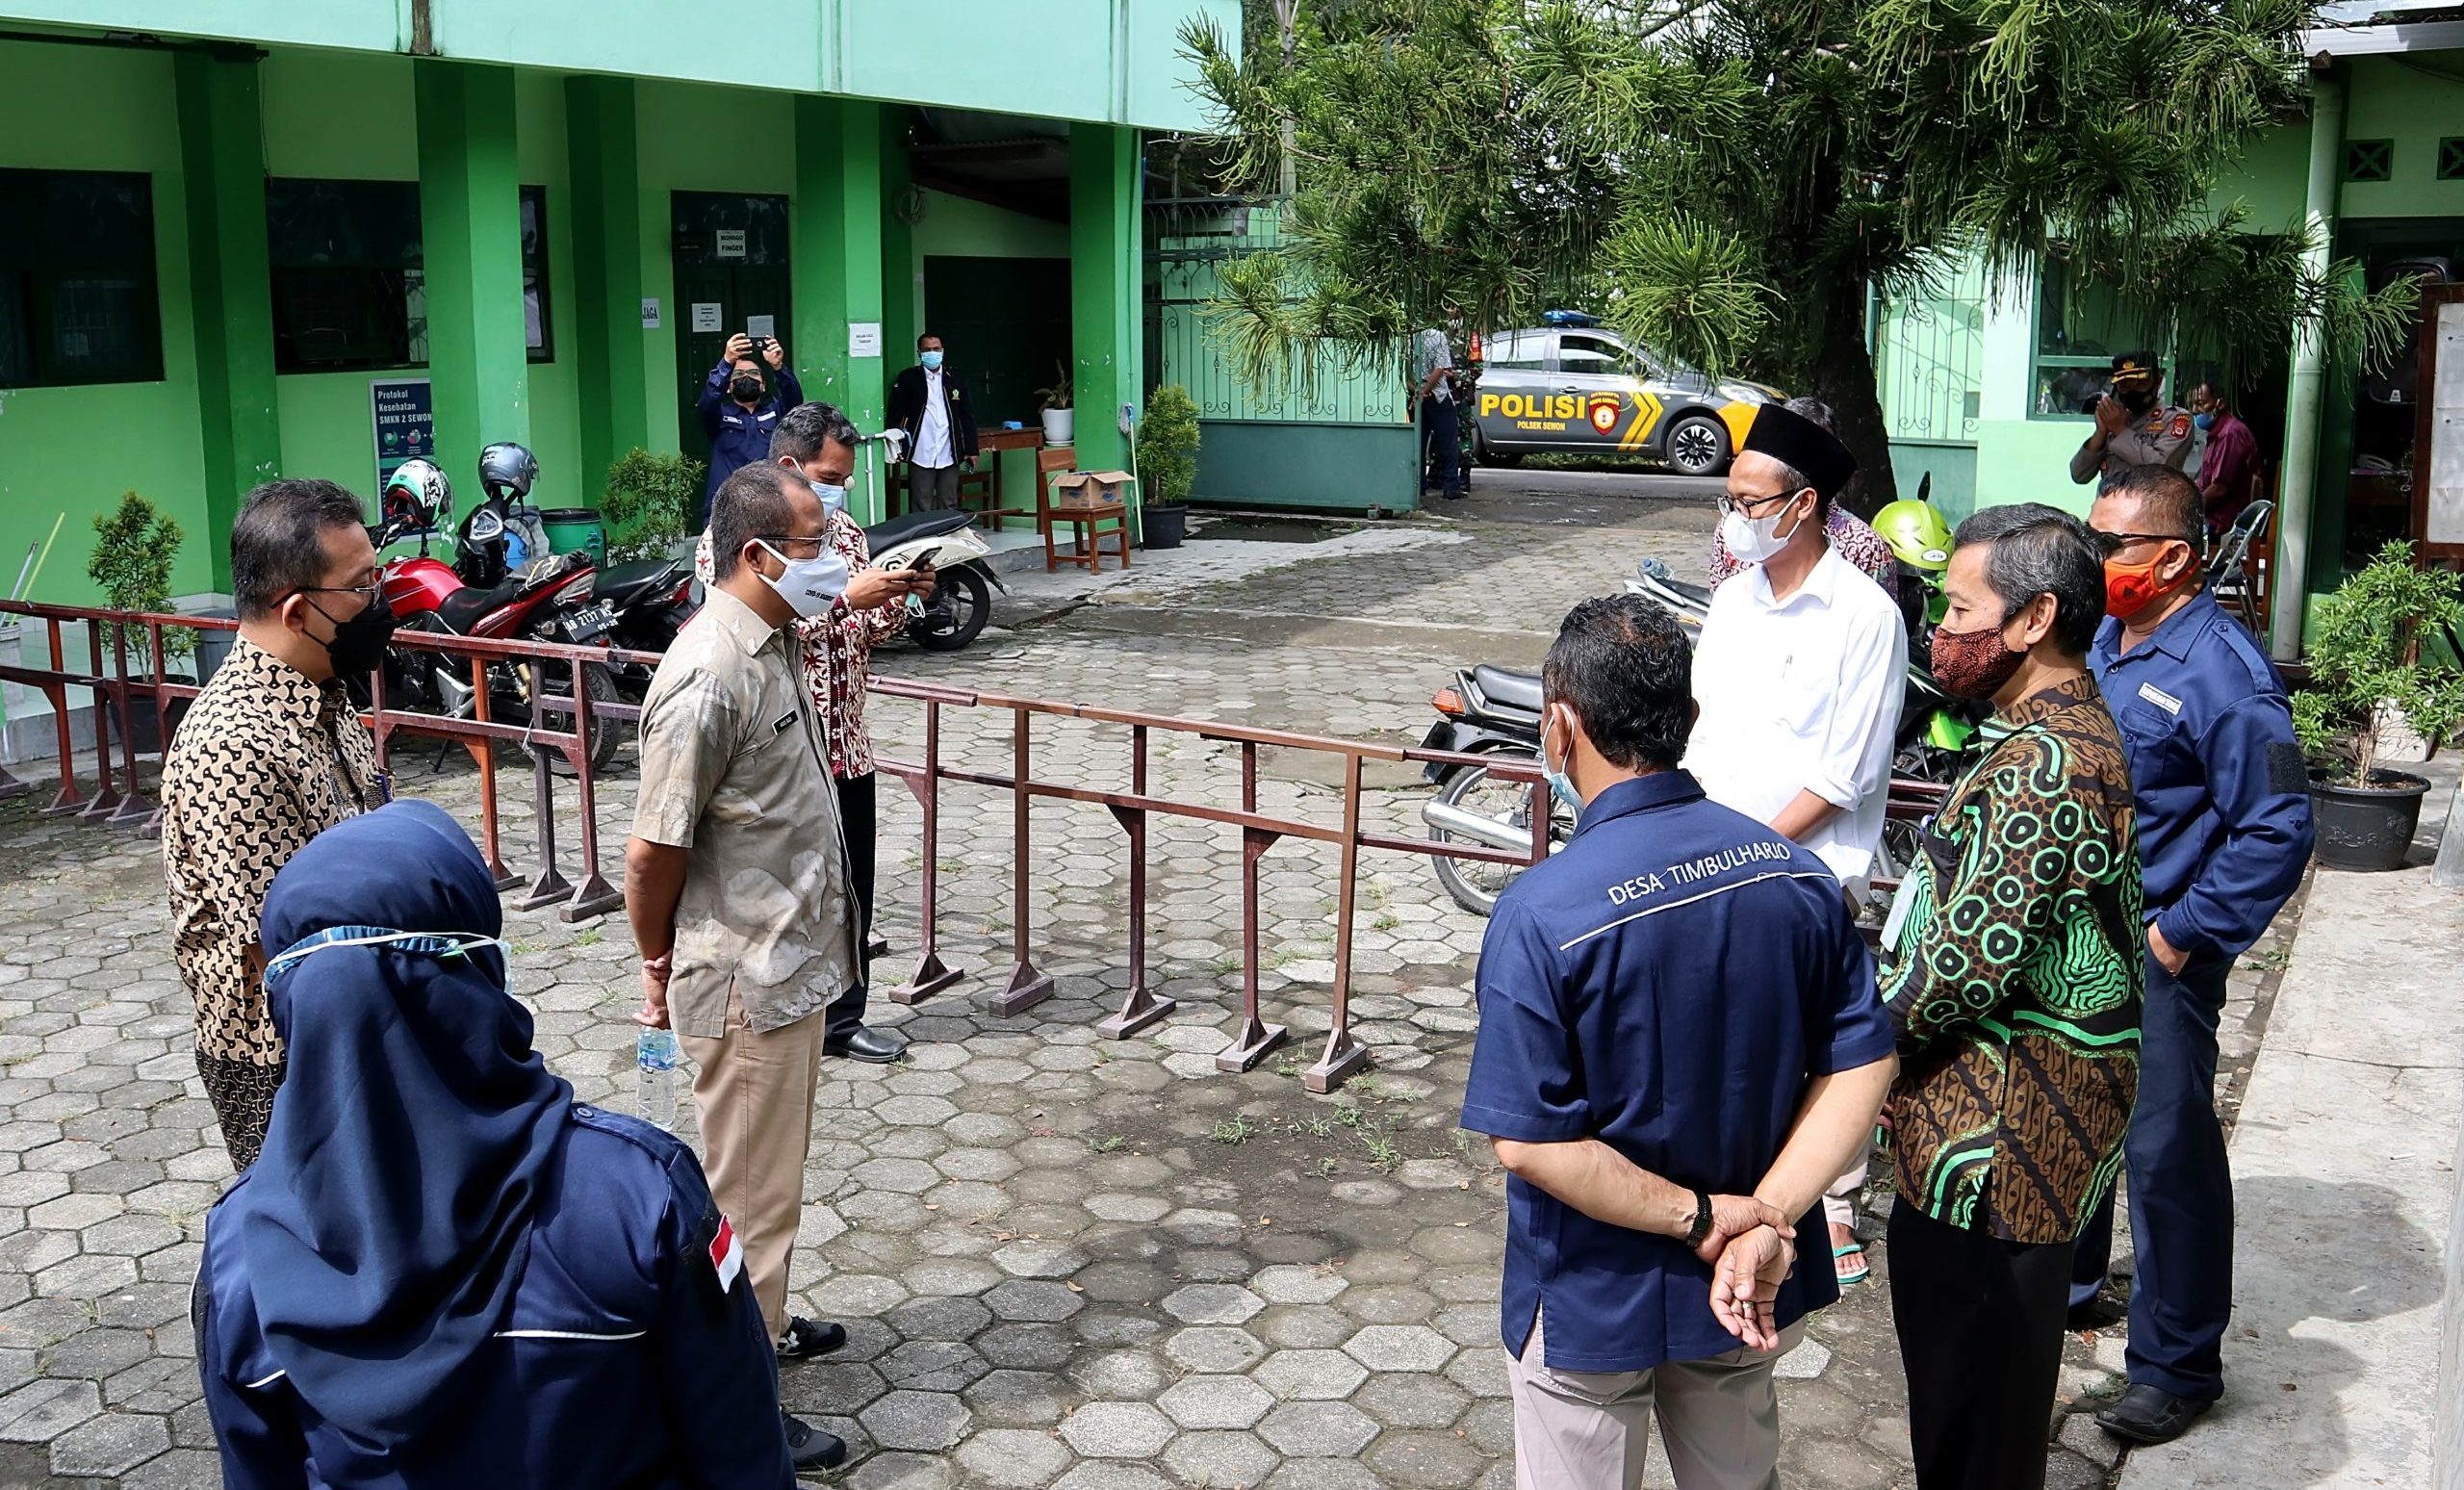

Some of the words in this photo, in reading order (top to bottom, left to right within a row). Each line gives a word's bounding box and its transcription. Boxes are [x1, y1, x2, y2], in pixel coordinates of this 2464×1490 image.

[378, 390, 409, 399] Protokol
[379, 402, 417, 412] Kesehatan
[1480, 394, 1586, 420] POLISI
[380, 416, 399, 424] SMKN
[407, 413, 431, 423] SEWON
[1517, 421, 1542, 430] POLSEK
[1542, 422, 1566, 431] SEWON
[563, 619, 578, 631] AB
[578, 610, 600, 627] 2137
[1607, 872, 1666, 906] DESA
[1666, 841, 1791, 886] TIMBULHARJO
